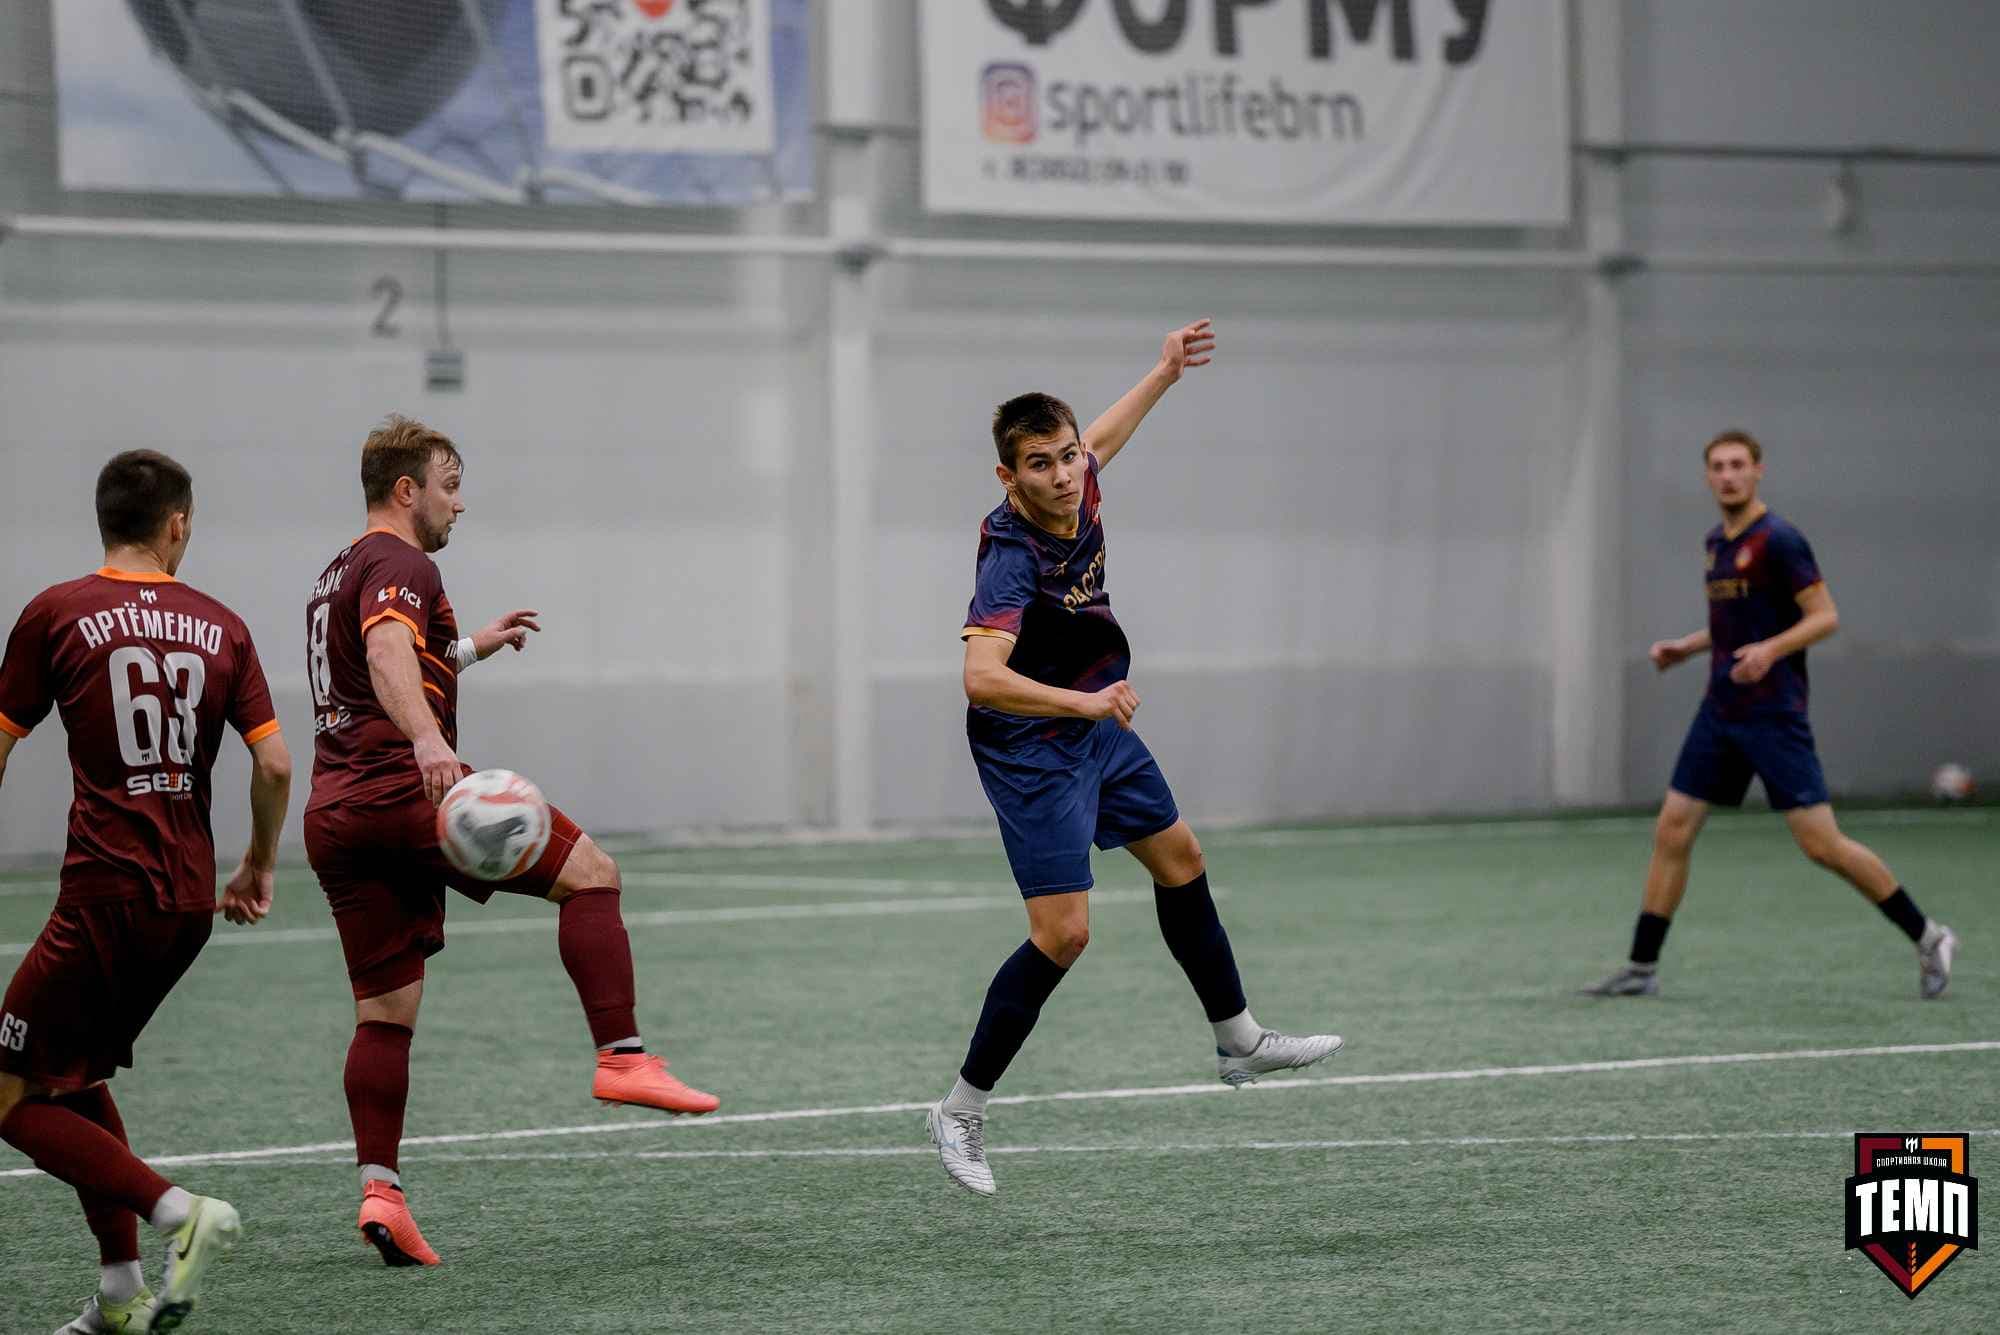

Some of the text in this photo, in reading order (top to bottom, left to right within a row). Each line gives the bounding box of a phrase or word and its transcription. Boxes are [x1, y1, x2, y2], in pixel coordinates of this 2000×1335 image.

[371, 276, 402, 339] 2
[77, 601, 223, 656] АРТЁМЕНКО
[108, 646, 206, 768] 63
[0, 1011, 29, 1052] 63
